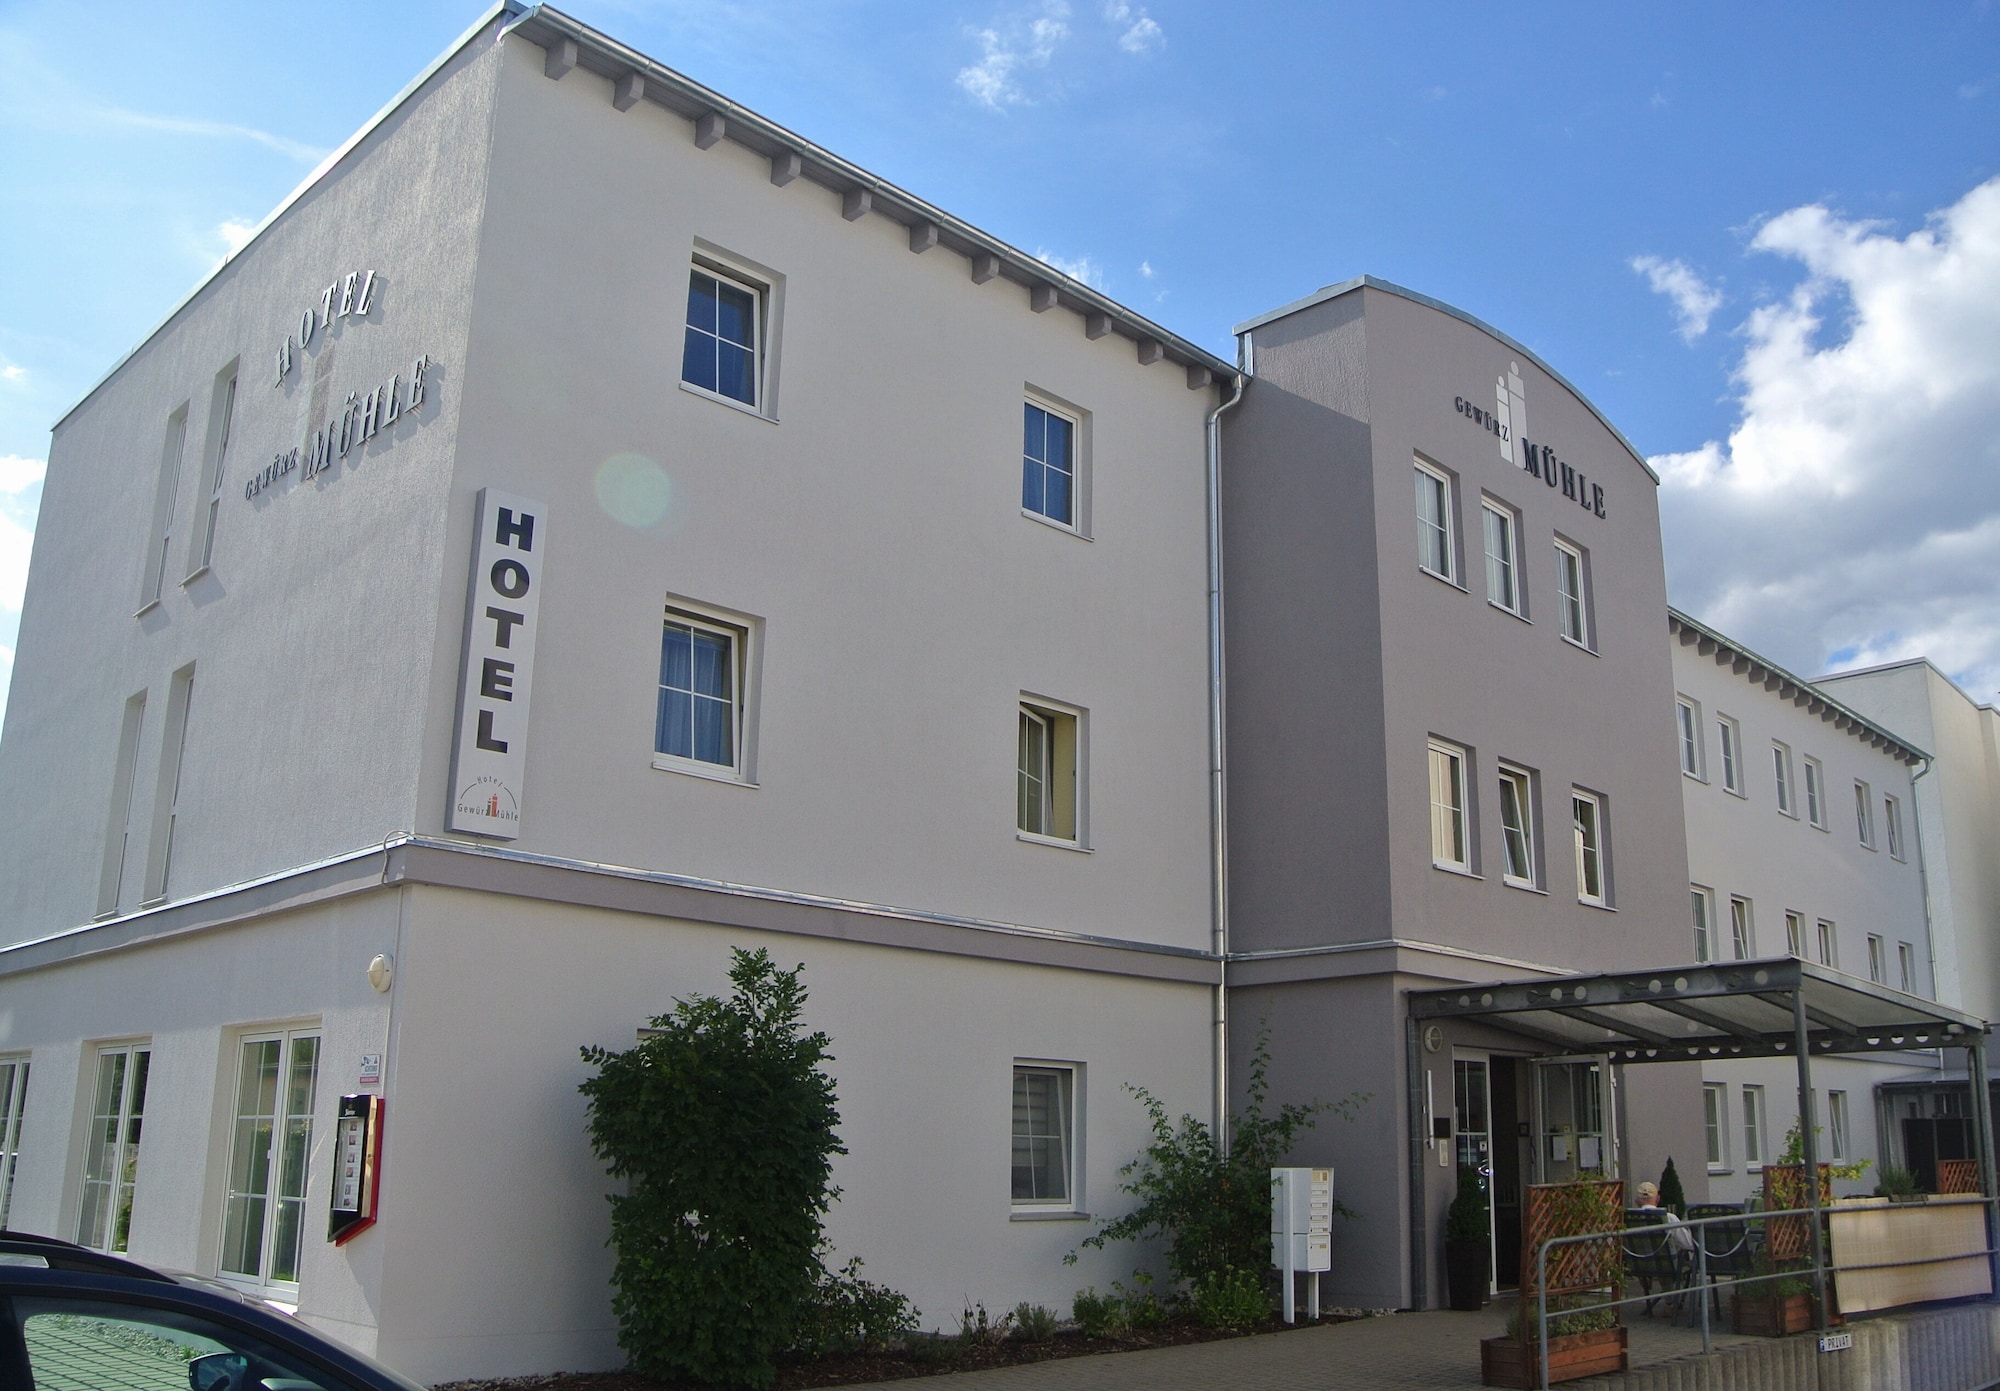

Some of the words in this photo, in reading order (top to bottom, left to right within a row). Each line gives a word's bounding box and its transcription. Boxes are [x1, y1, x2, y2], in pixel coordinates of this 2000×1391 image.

[275, 269, 376, 388] HOTEL
[245, 446, 299, 500] GEWÜRZ
[305, 354, 428, 480] MÜHLE
[1454, 395, 1509, 442] GEWÜRZ
[1522, 437, 1607, 519] MÜHLE
[475, 506, 535, 754] HOTEL
[477, 775, 503, 788] Hotel
[1827, 1335, 1849, 1349] PRIVAT
